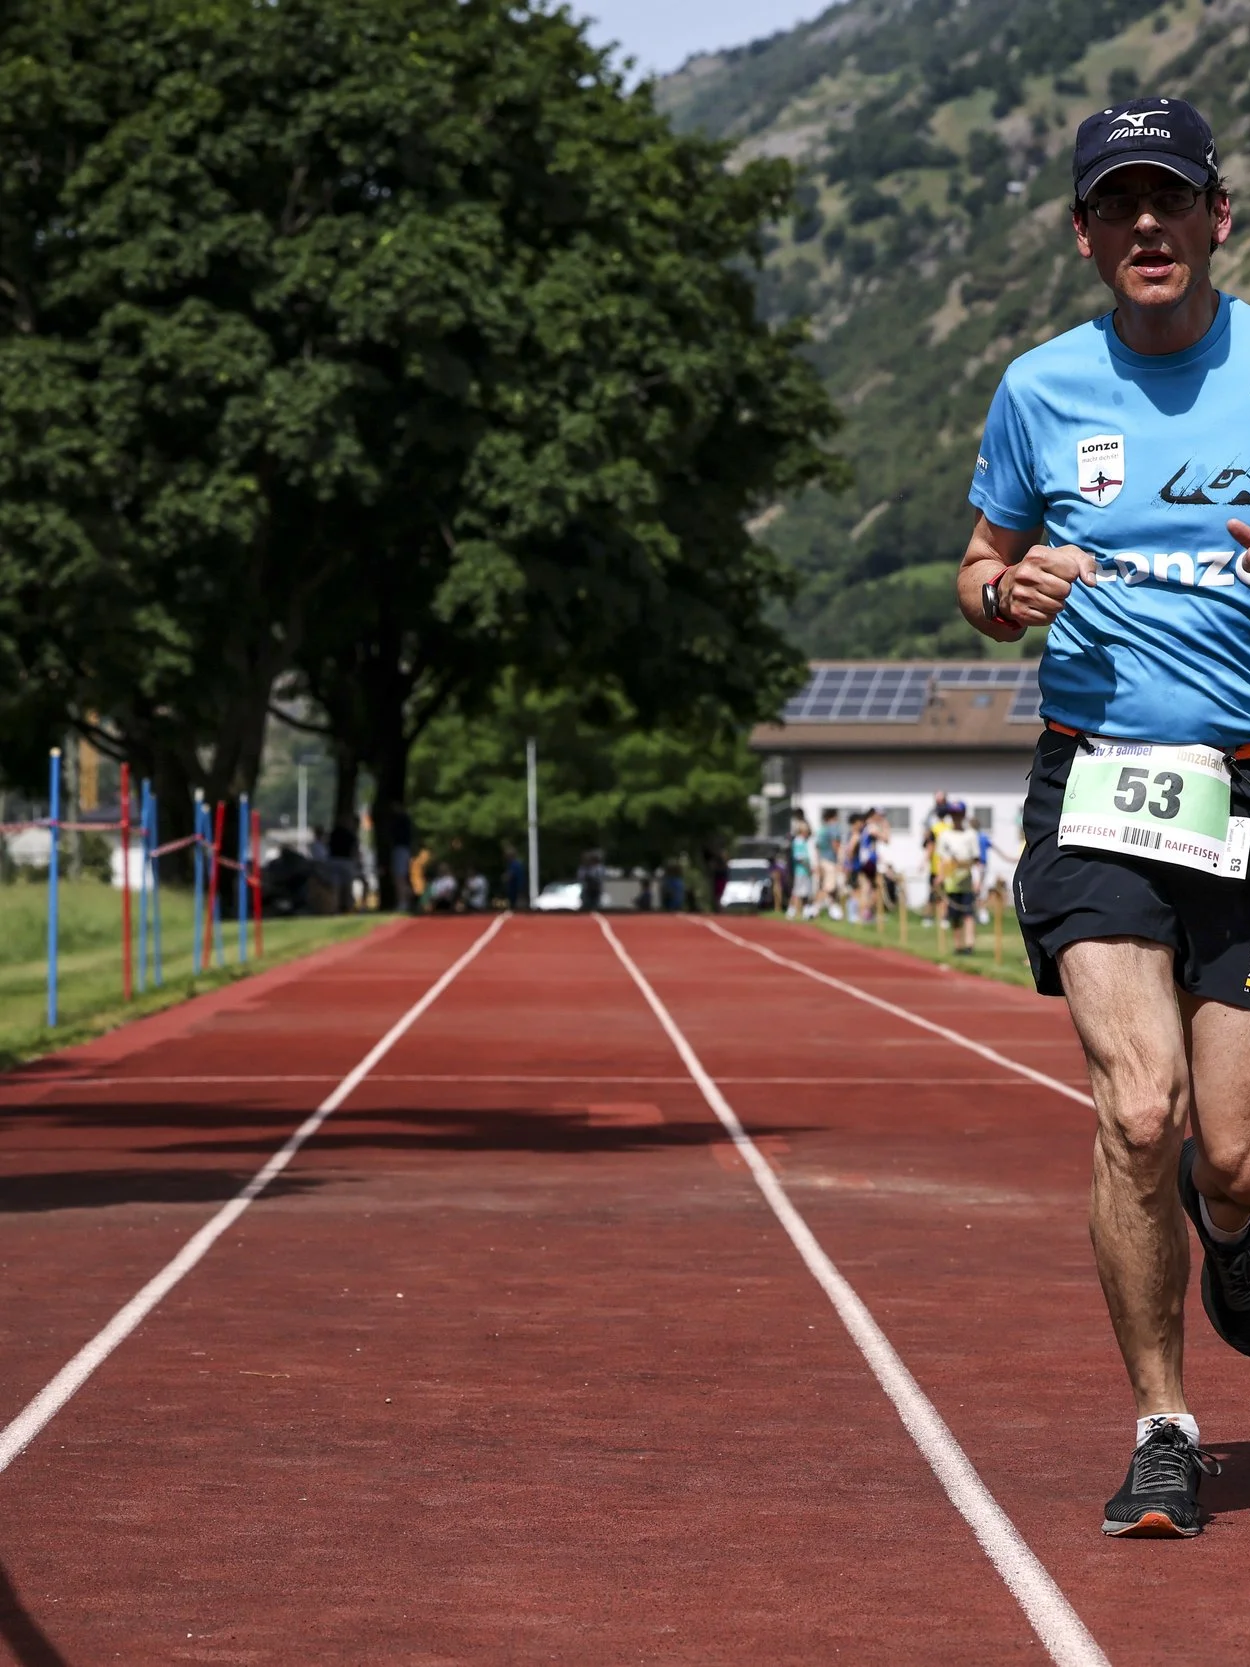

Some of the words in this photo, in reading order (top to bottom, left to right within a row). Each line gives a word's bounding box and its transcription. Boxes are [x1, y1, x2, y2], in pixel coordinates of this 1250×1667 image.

[1106, 127, 1171, 143] MIZUNO
[1081, 441, 1119, 454] Lonza
[1113, 766, 1185, 820] 53
[1061, 823, 1117, 839] RAIFFEISEN
[1164, 839, 1220, 862] RAIFFEISEN
[1229, 857, 1242, 872] 53
